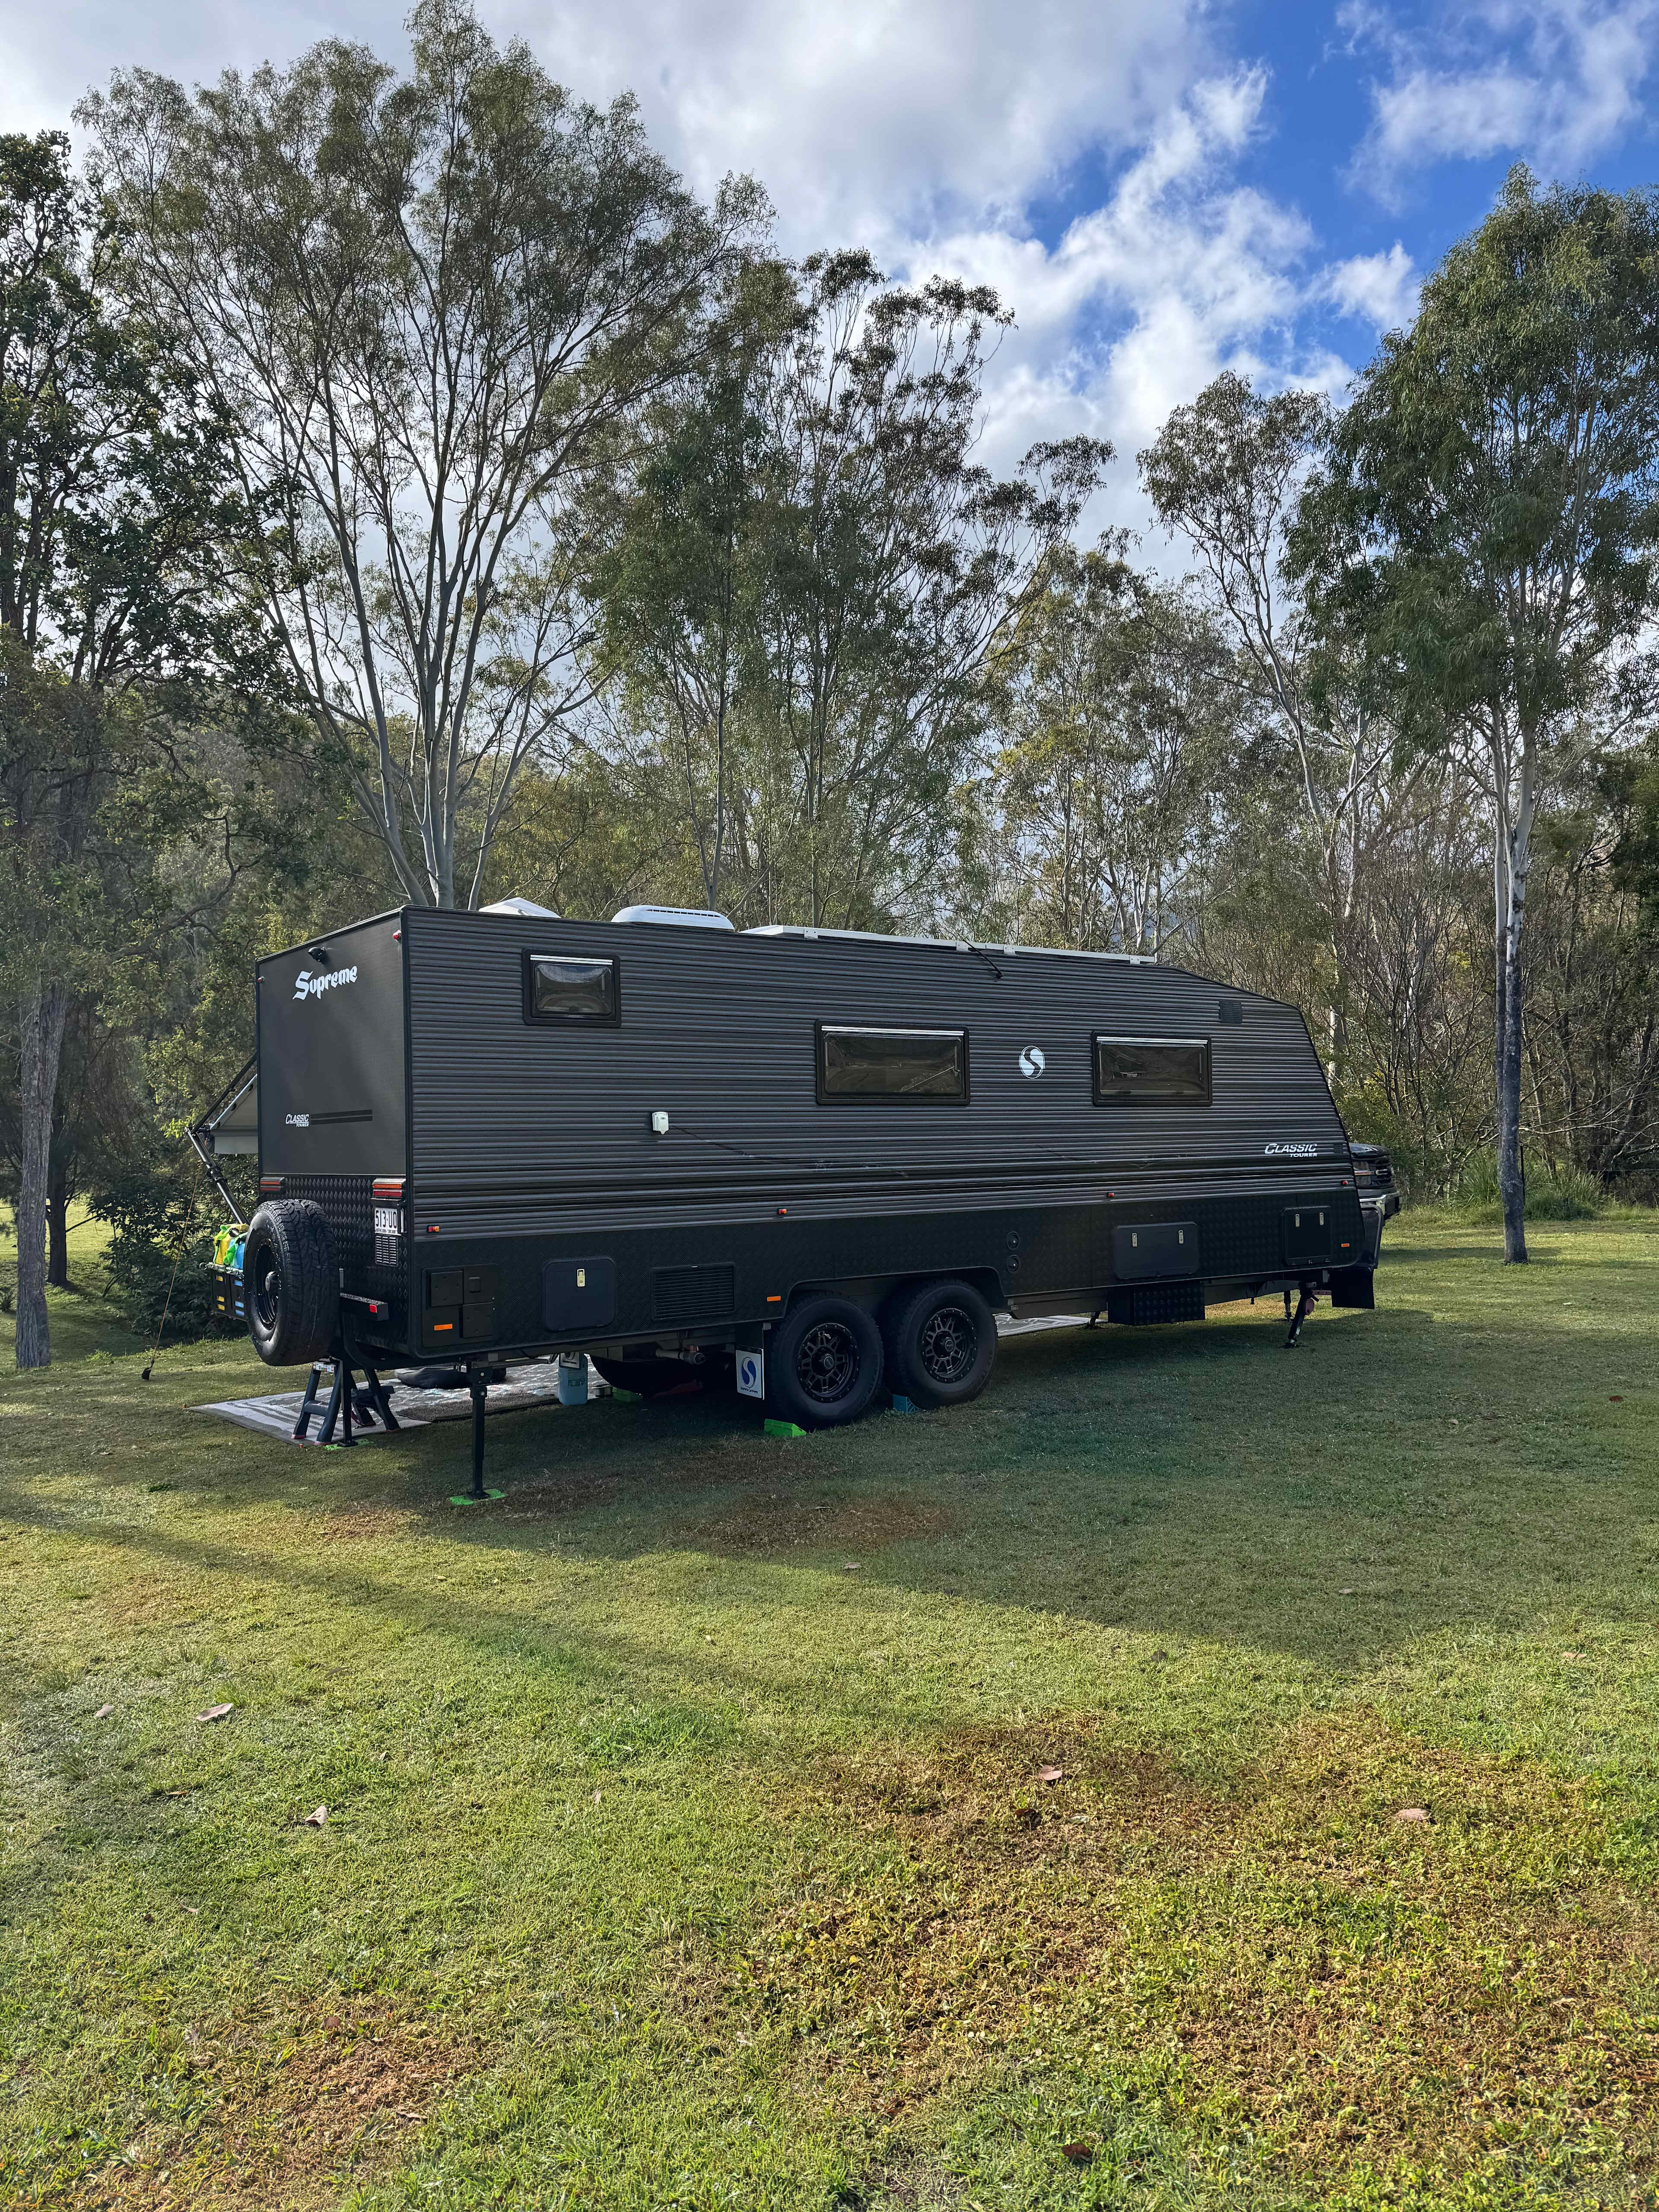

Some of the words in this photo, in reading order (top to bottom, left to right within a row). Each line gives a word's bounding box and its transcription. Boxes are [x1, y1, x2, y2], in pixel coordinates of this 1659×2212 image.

[292, 966, 358, 1000] Supreme
[286, 1114, 309, 1124] CLASSIC
[1265, 1143, 1317, 1154] CLASSIC
